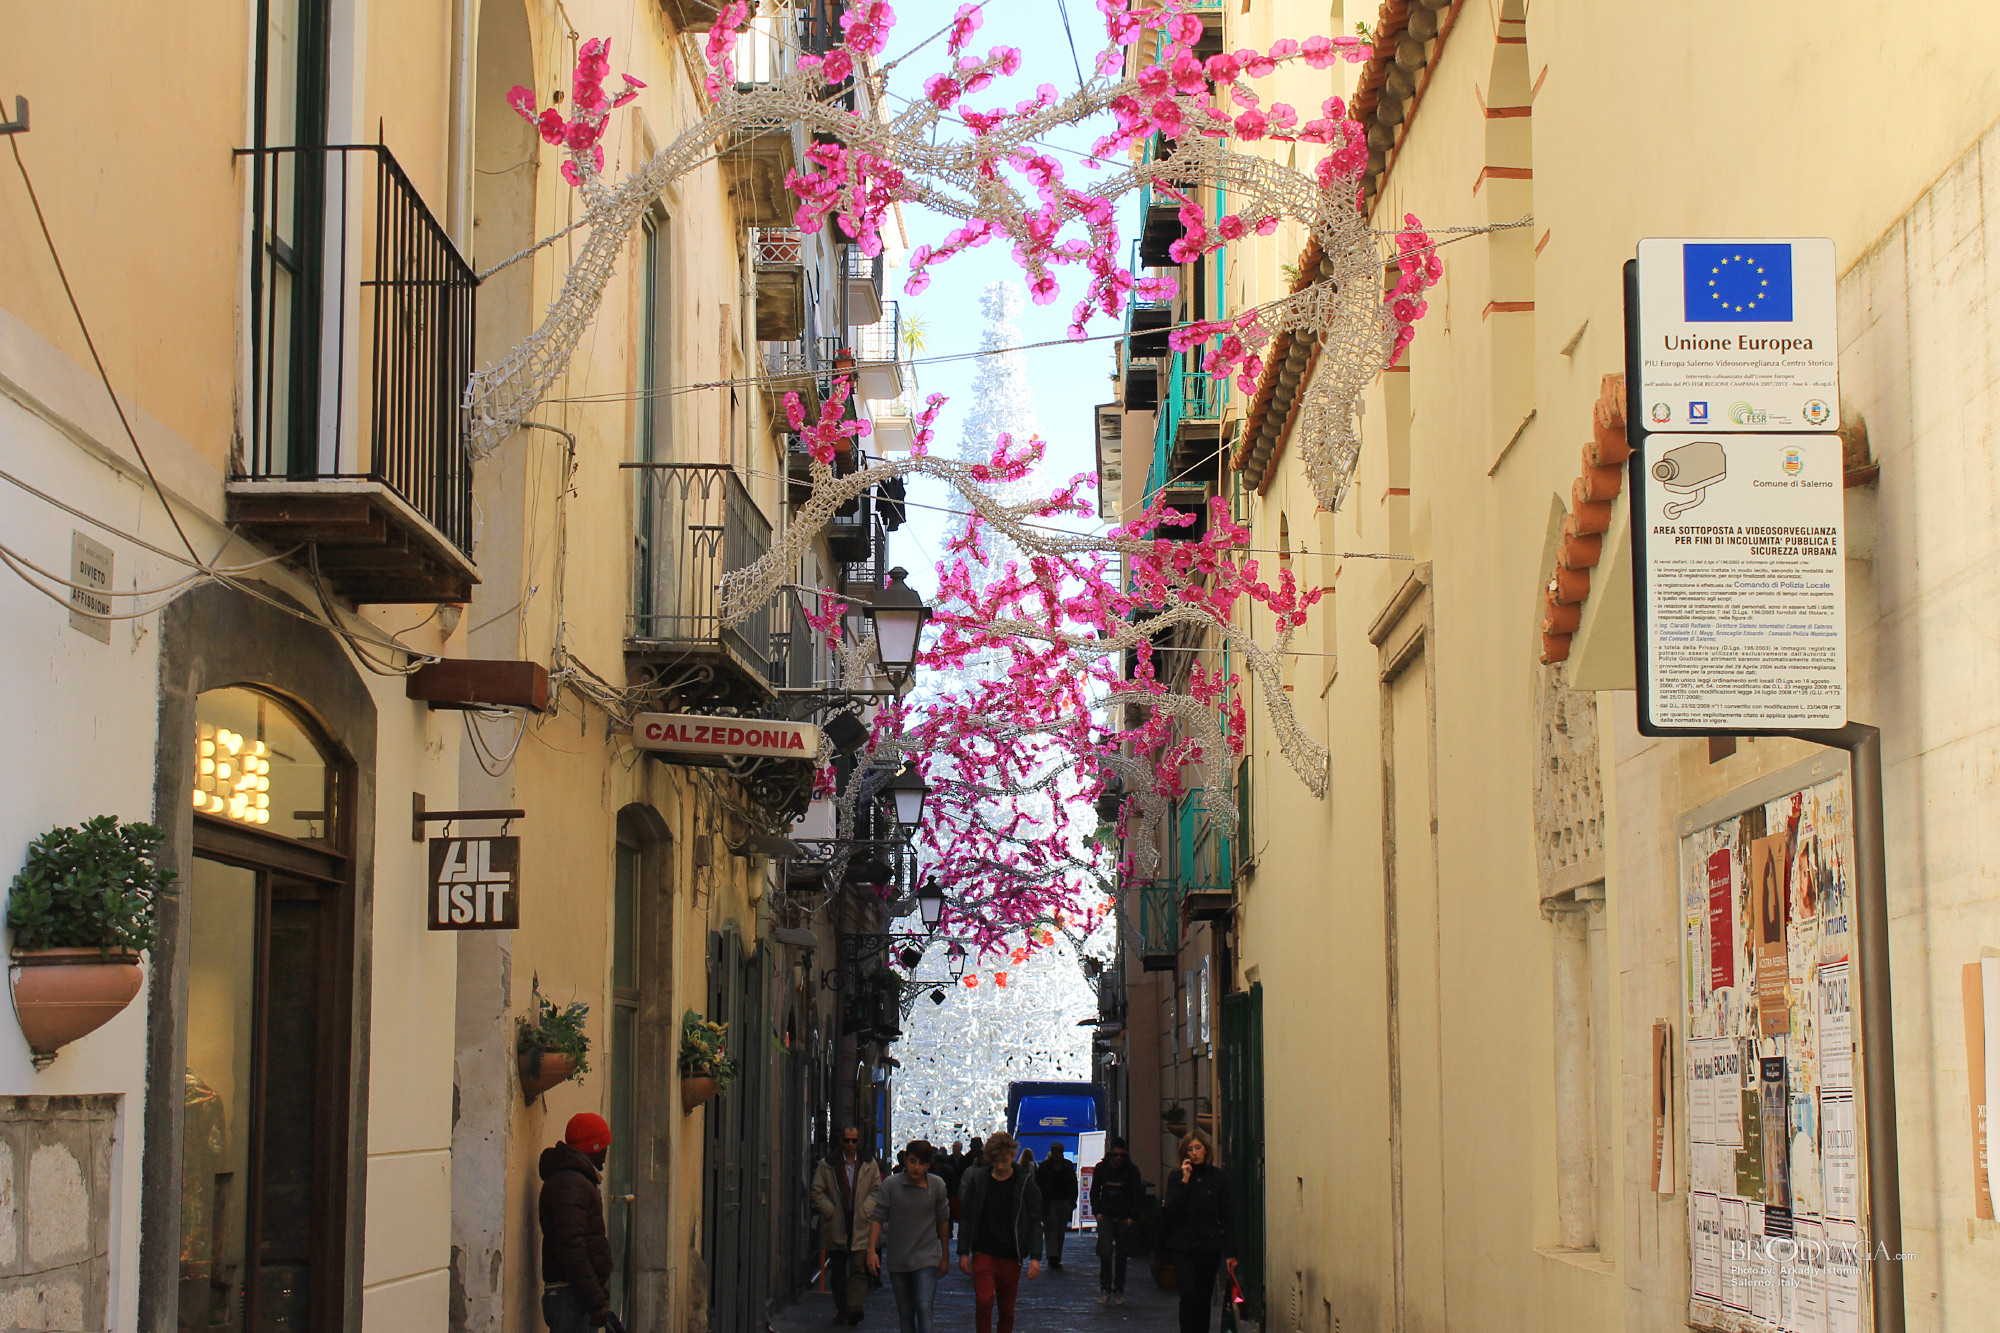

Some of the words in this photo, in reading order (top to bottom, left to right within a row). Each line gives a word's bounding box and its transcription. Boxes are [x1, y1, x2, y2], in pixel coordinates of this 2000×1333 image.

[1664, 334, 1732, 351] Unione
[1738, 335, 1813, 355] Europea
[1660, 360, 1685, 368] Europa
[1715, 360, 1780, 368] Videosorveglianza
[1746, 415, 1767, 423] FESR
[1752, 480, 1788, 488] Comune
[1790, 480, 1798, 488] di
[1800, 480, 1833, 488] Salerno
[1653, 526, 1676, 535] AREA
[1678, 526, 1734, 535] SOTTOPOSTA
[1737, 526, 1743, 535] A
[1745, 526, 1837, 535] VIDEOSORVEGLIANZA
[1674, 536, 1692, 545] PER
[1694, 536, 1712, 545] FINI
[1715, 536, 1724, 545] DI
[1726, 536, 1783, 545] INCOLUMITA'
[1785, 537, 1829, 545] PUBBLICA
[1831, 537, 1837, 545] E
[1750, 547, 1799, 555] SICUREZZA
[1801, 547, 1837, 556] URBANA
[80, 561, 106, 585] DIVIETO
[1734, 581, 1770, 589] Comando
[1771, 581, 1779, 589] di
[1780, 581, 1805, 589] Polizia
[1806, 581, 1831, 589] Locale
[645, 723, 805, 750] CALZEDONIA
